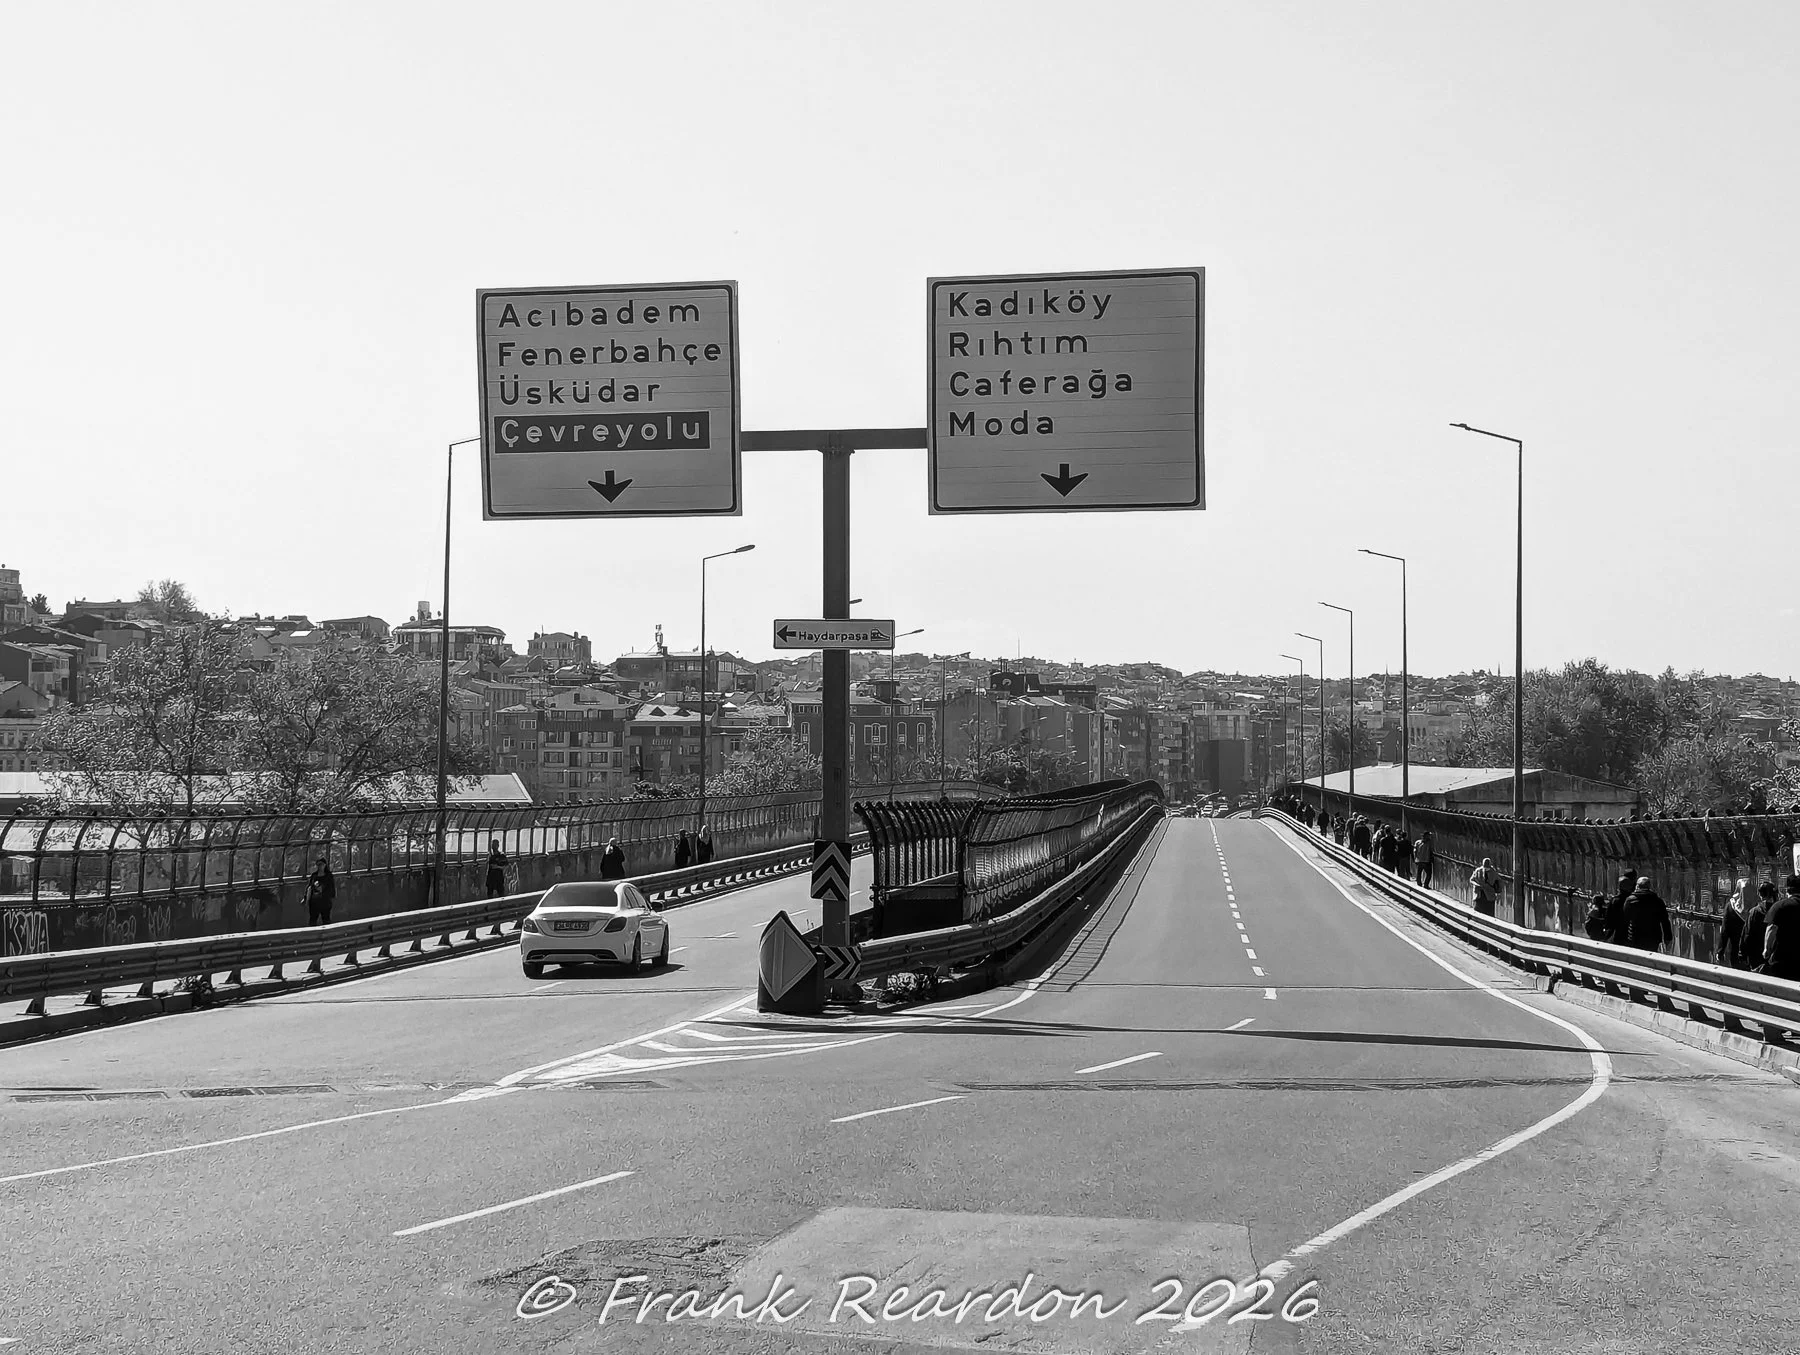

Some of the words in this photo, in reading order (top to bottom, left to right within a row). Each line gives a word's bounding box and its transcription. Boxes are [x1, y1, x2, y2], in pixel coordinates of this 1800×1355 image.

[498, 300, 700, 328] Acıbadem
[949, 289, 1111, 319] Kadıköy
[498, 337, 722, 366] Fenerbahçe
[949, 330, 1088, 357] Rıhtım
[499, 374, 660, 405] Üsküdar
[949, 369, 1133, 399] Caferağa
[500, 415, 701, 448] Çevreyolu
[949, 409, 1054, 437] Moda
[798, 631, 868, 643] Haydarpaşa
